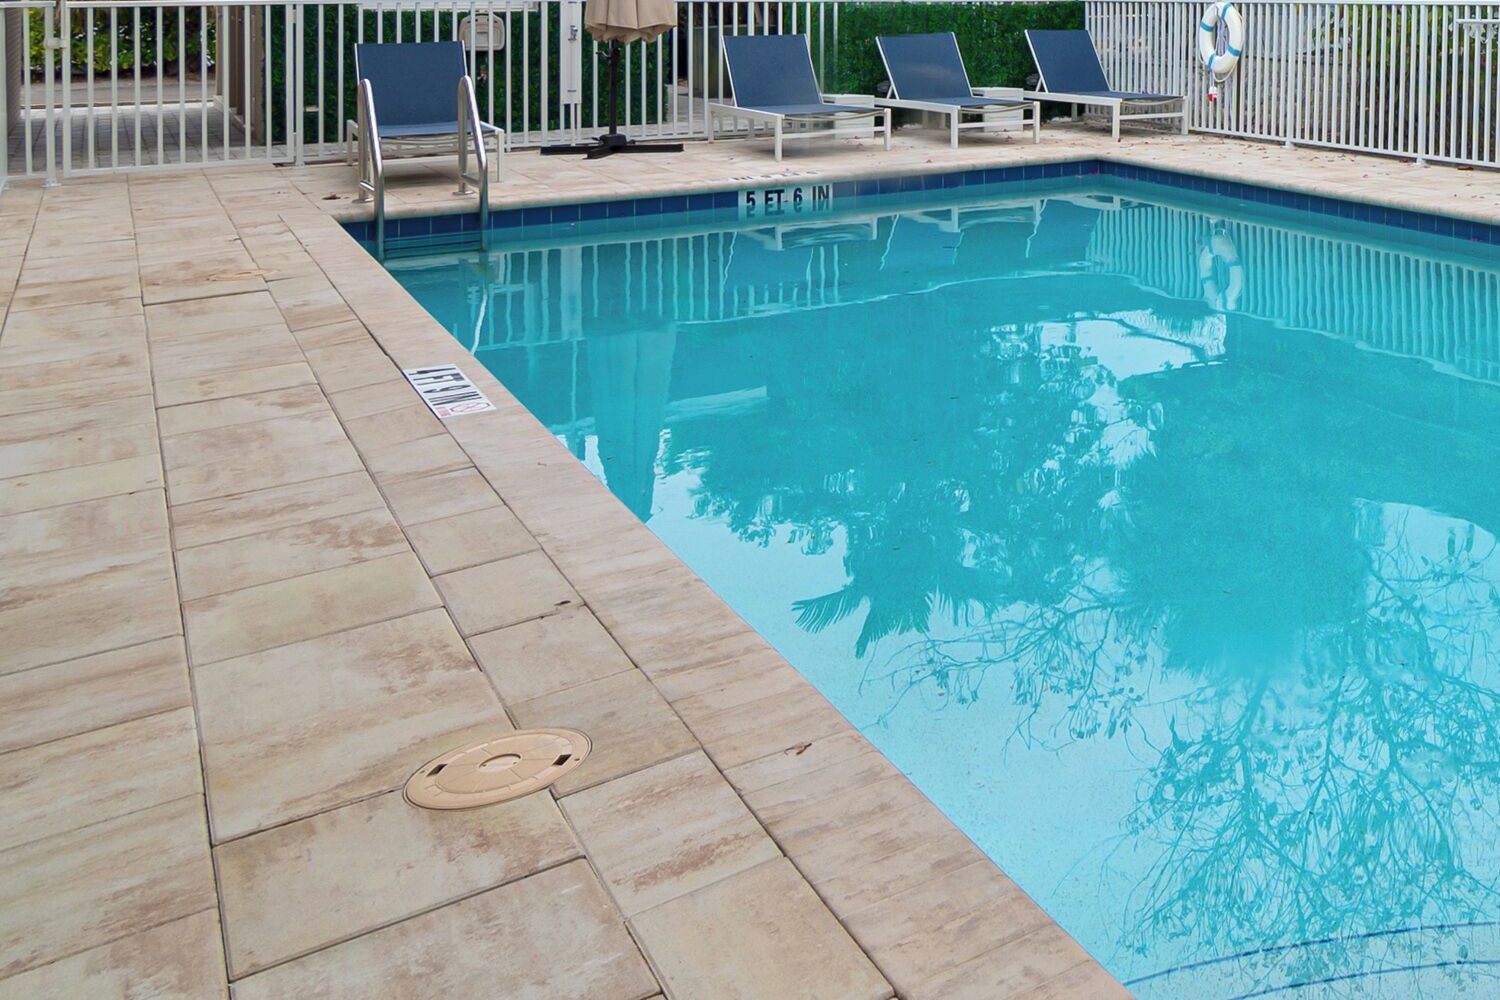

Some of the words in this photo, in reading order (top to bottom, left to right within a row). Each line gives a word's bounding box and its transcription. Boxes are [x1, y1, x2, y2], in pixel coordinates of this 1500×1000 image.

[746, 191, 755, 206] 5
[793, 187, 803, 202] 6
[812, 185, 830, 200] IN
[413, 373, 465, 386] FT
[428, 391, 483, 406] IN
